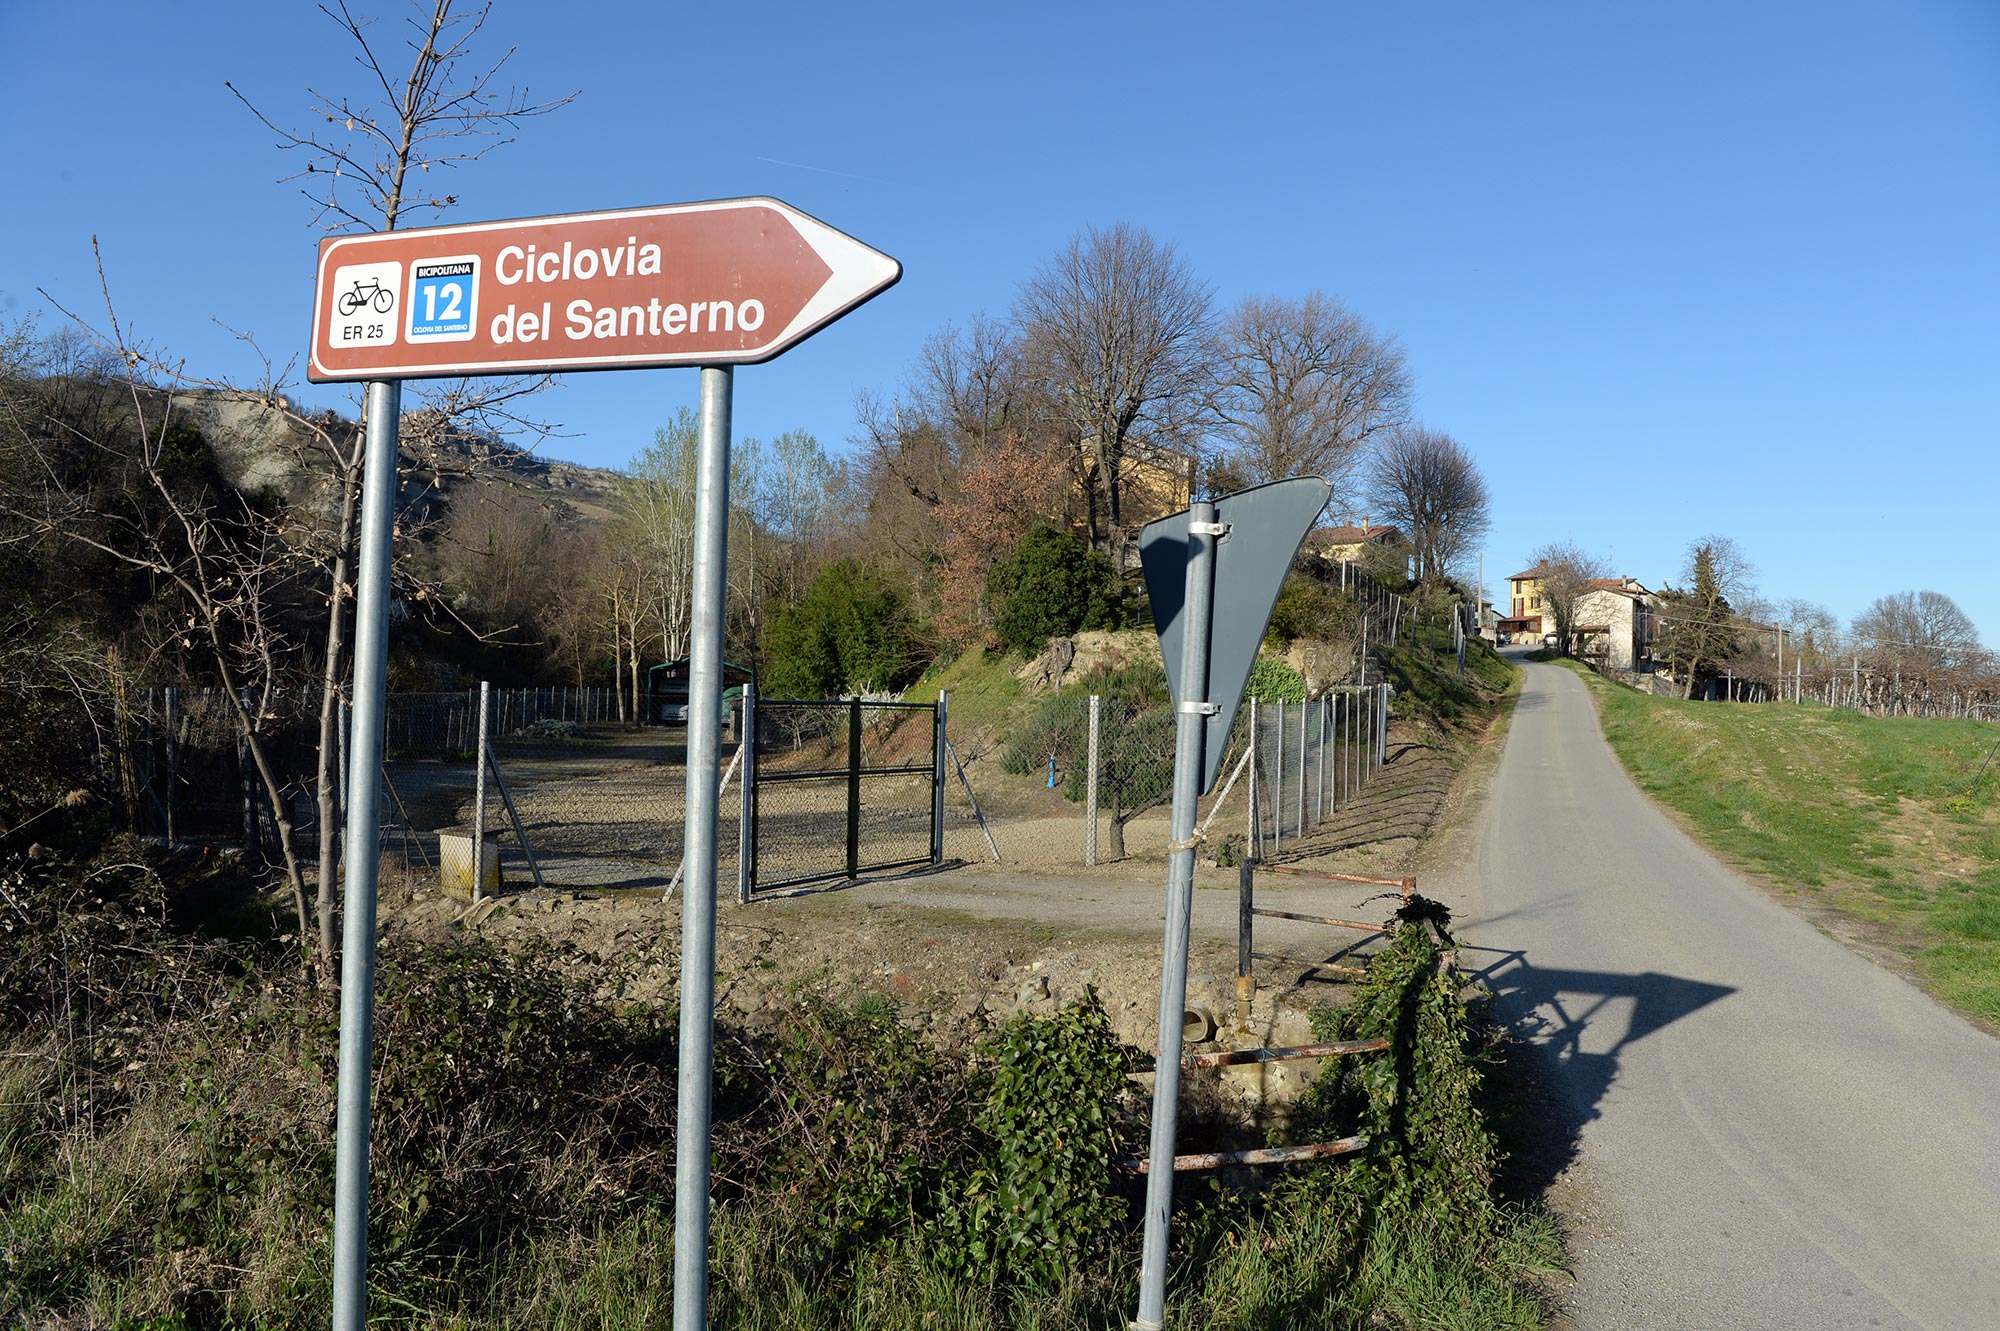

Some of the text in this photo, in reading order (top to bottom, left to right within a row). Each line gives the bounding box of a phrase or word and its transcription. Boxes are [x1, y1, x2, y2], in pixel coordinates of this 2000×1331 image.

[419, 265, 470, 277] BICIPOLITANA
[495, 235, 662, 286] Ciclovia
[423, 282, 463, 321] 12
[343, 324, 384, 340] ER 25
[413, 323, 468, 334] CICLOVIA DEL SANTERNO
[490, 297, 765, 346] del Santerno
